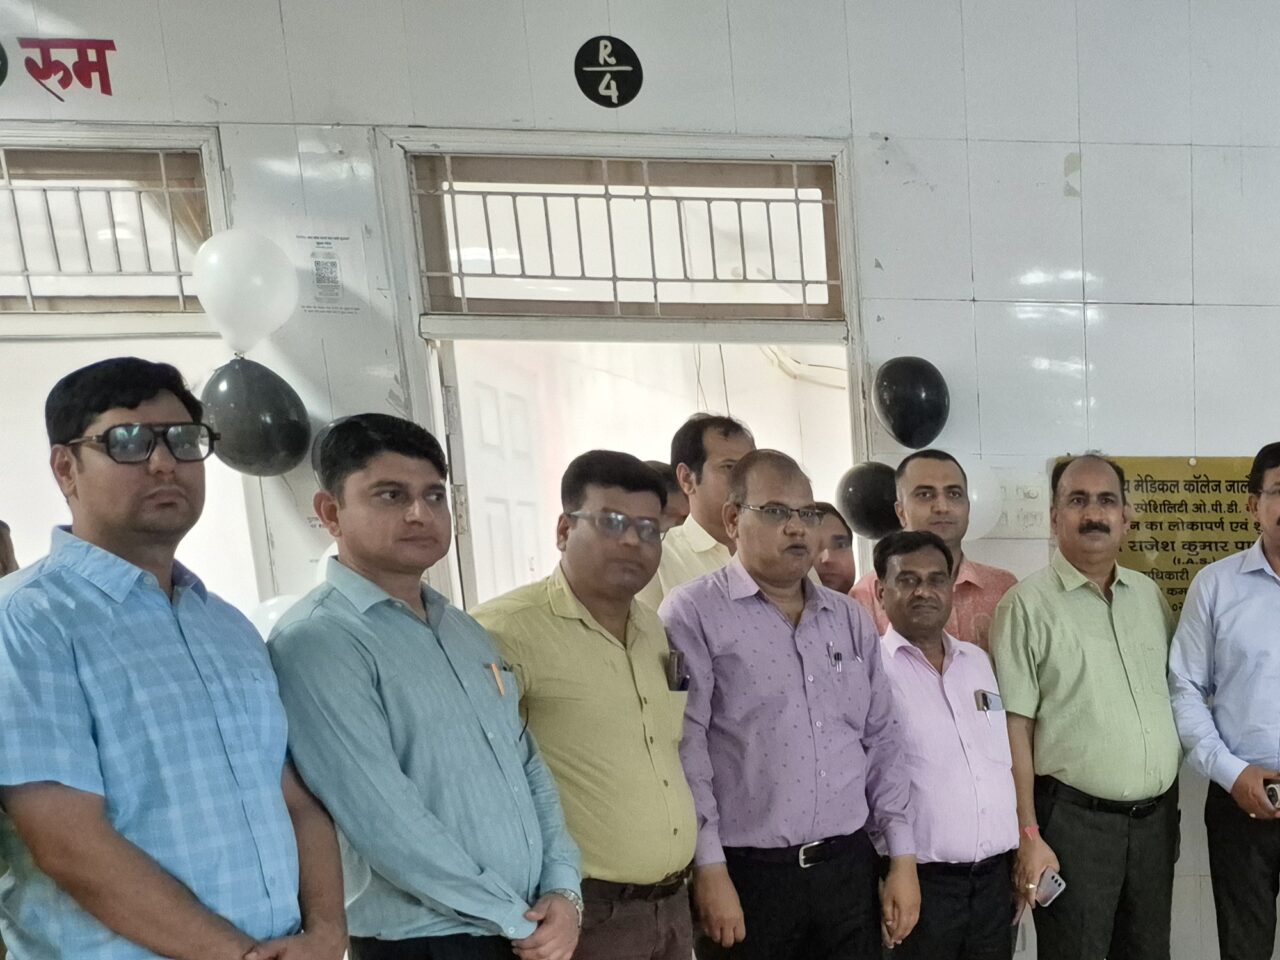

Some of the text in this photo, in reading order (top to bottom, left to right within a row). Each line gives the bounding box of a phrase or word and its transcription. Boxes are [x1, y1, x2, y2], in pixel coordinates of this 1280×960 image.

[598, 39, 617, 65] R
[598, 72, 619, 104] 4
[1134, 473, 1180, 494] मेडिकल
[1183, 474, 1222, 494] कॉलेज
[1144, 521, 1163, 532] का
[1229, 518, 1249, 532] एवं
[1128, 537, 1176, 552] राजेश
[1181, 540, 1229, 556] कुमार
